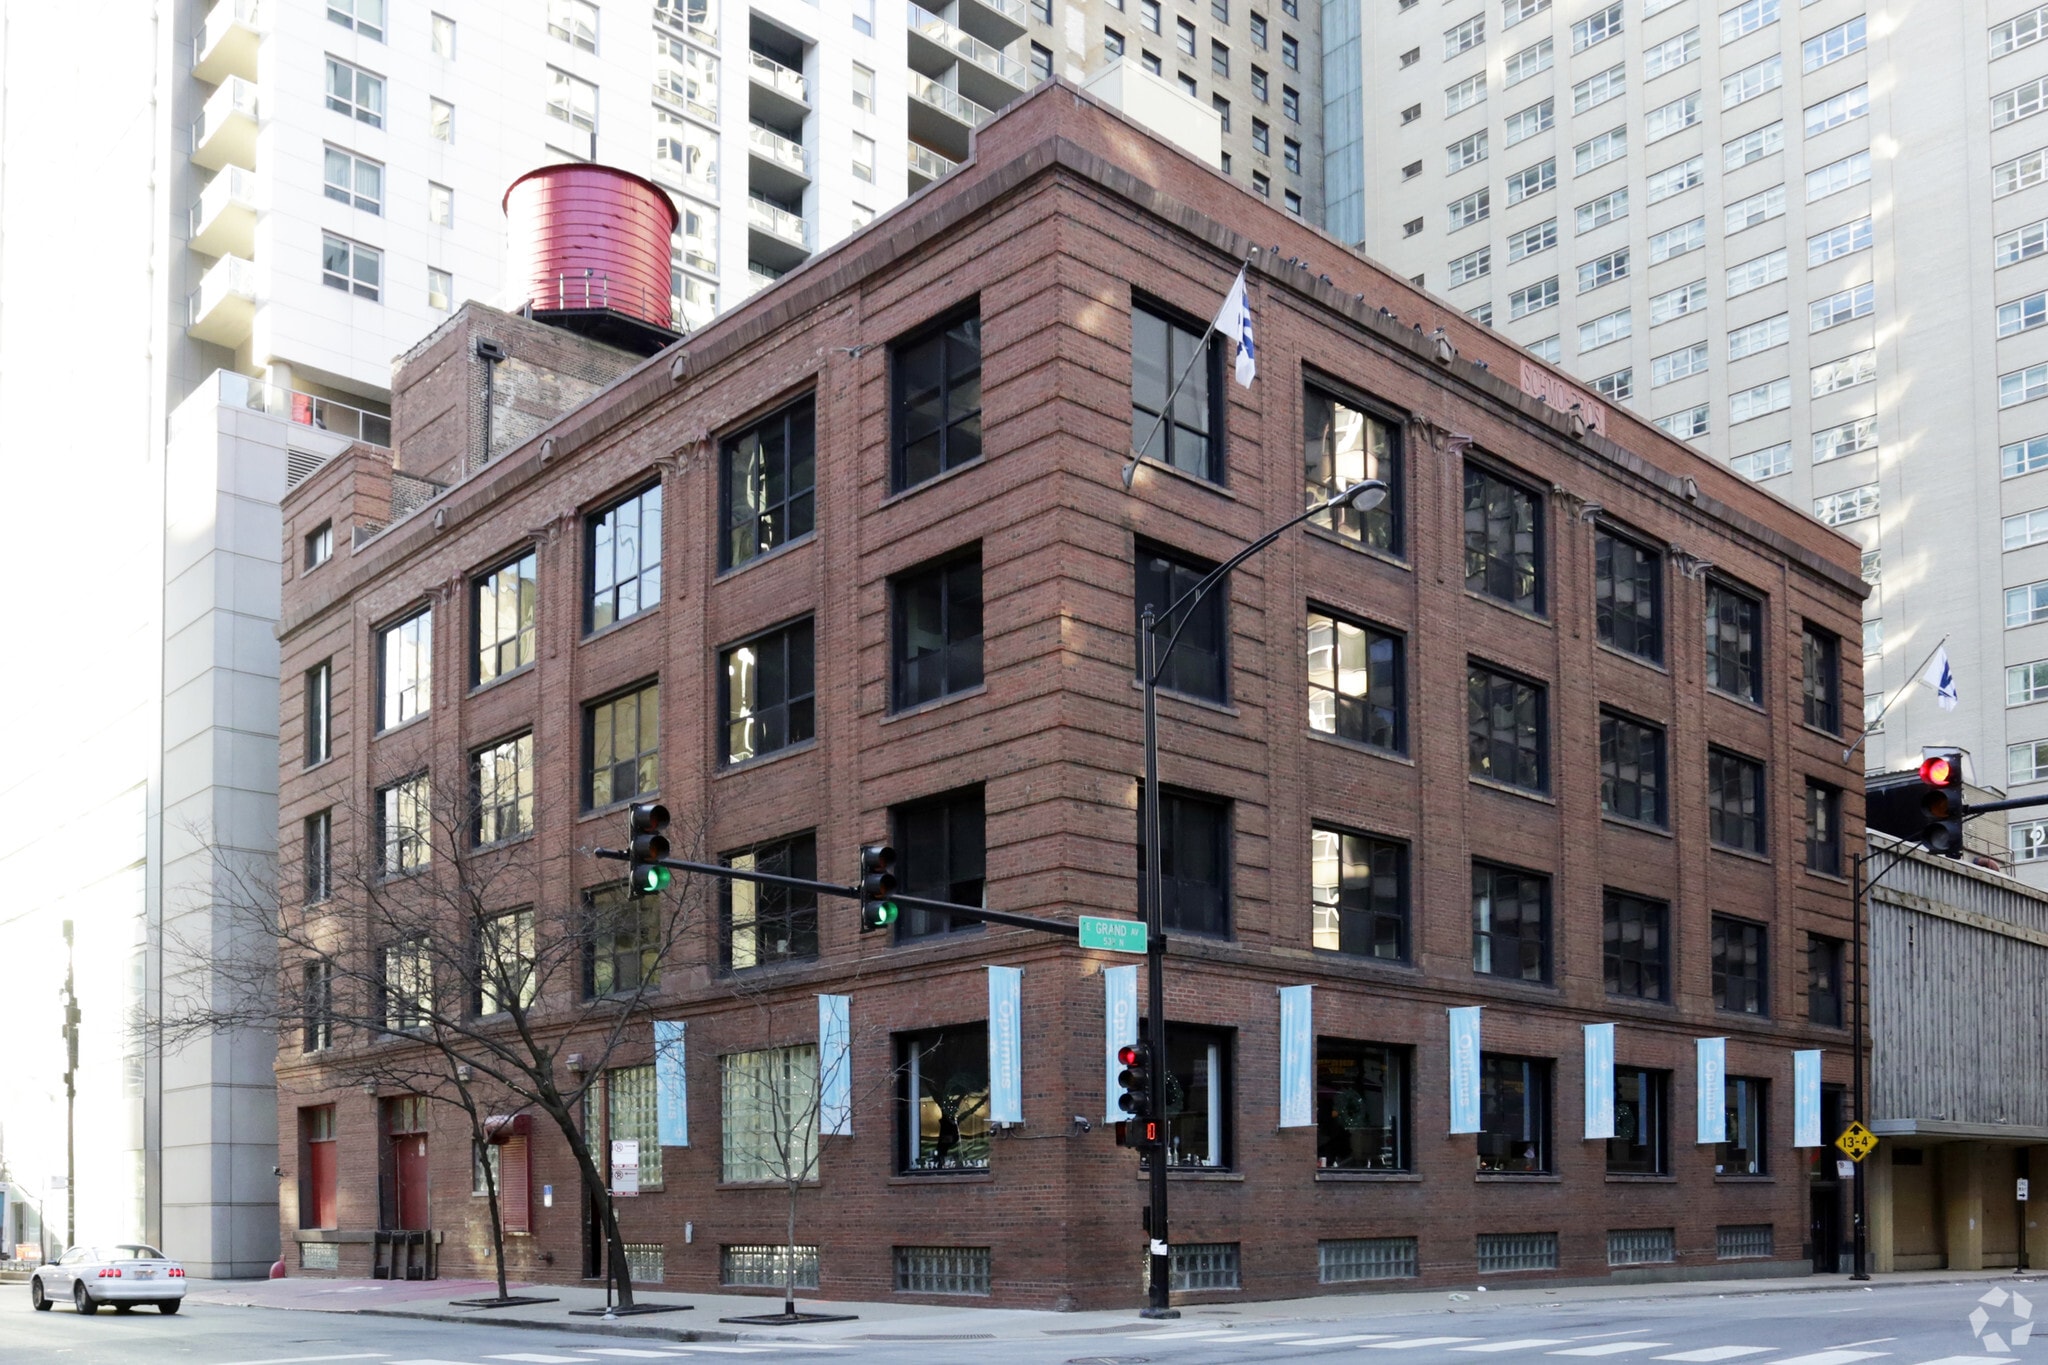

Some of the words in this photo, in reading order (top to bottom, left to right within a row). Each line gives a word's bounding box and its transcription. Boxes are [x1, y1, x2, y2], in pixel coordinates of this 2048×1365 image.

[1086, 922, 1091, 931] E
[1096, 922, 1127, 936] GRAND
[1130, 927, 1139, 936] AV
[1118, 938, 1125, 947] N
[997, 1000, 1014, 1089] Optimus
[1457, 1034, 1472, 1106] Optimus
[1705, 1060, 1718, 1120] Optimus
